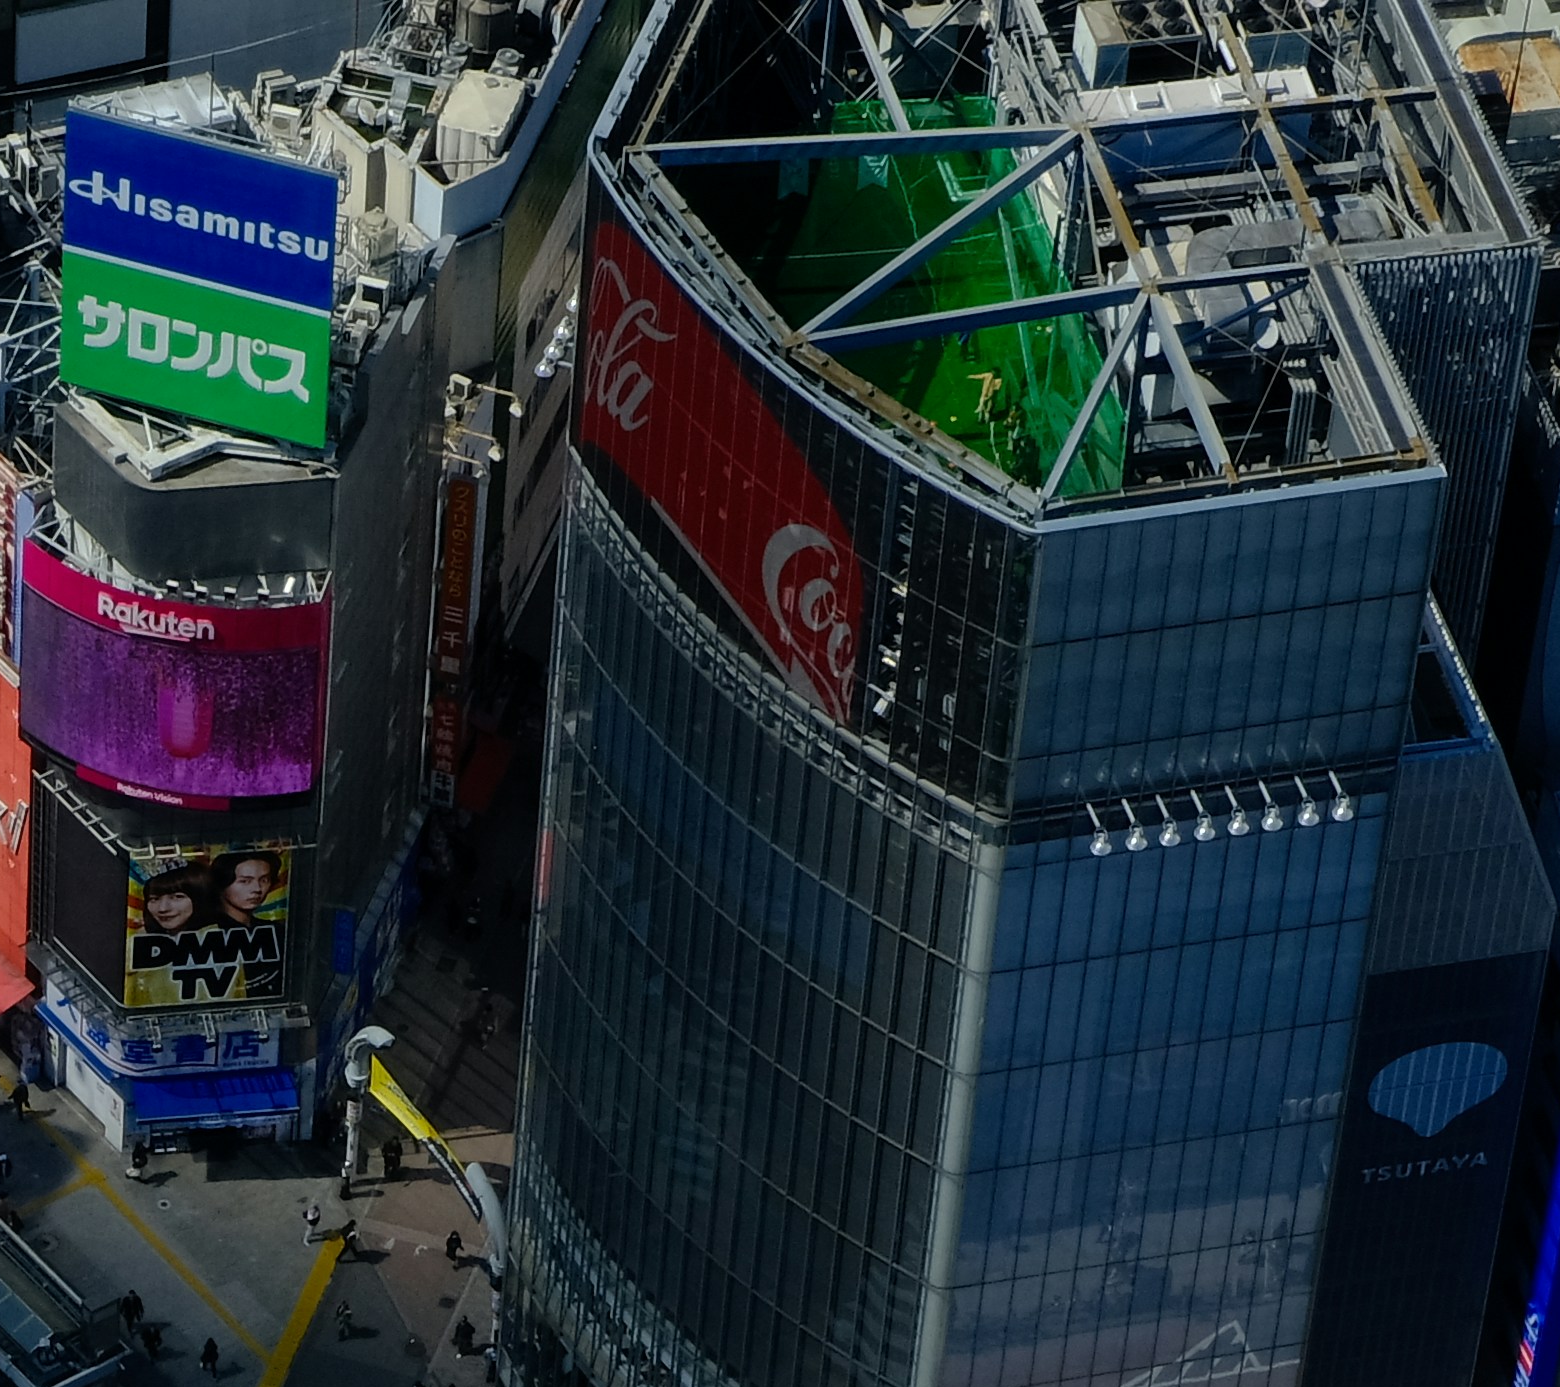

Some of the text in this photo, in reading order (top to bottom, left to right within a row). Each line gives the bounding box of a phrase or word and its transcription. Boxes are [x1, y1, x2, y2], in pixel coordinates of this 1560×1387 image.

[68, 170, 329, 262] Hisamitsu
[78, 294, 310, 404] サロンパス
[97, 591, 215, 643] Rakuten
[132, 925, 280, 971] DMM
[173, 965, 239, 1001] TV
[1361, 1151, 1489, 1185] TSUTAYA
